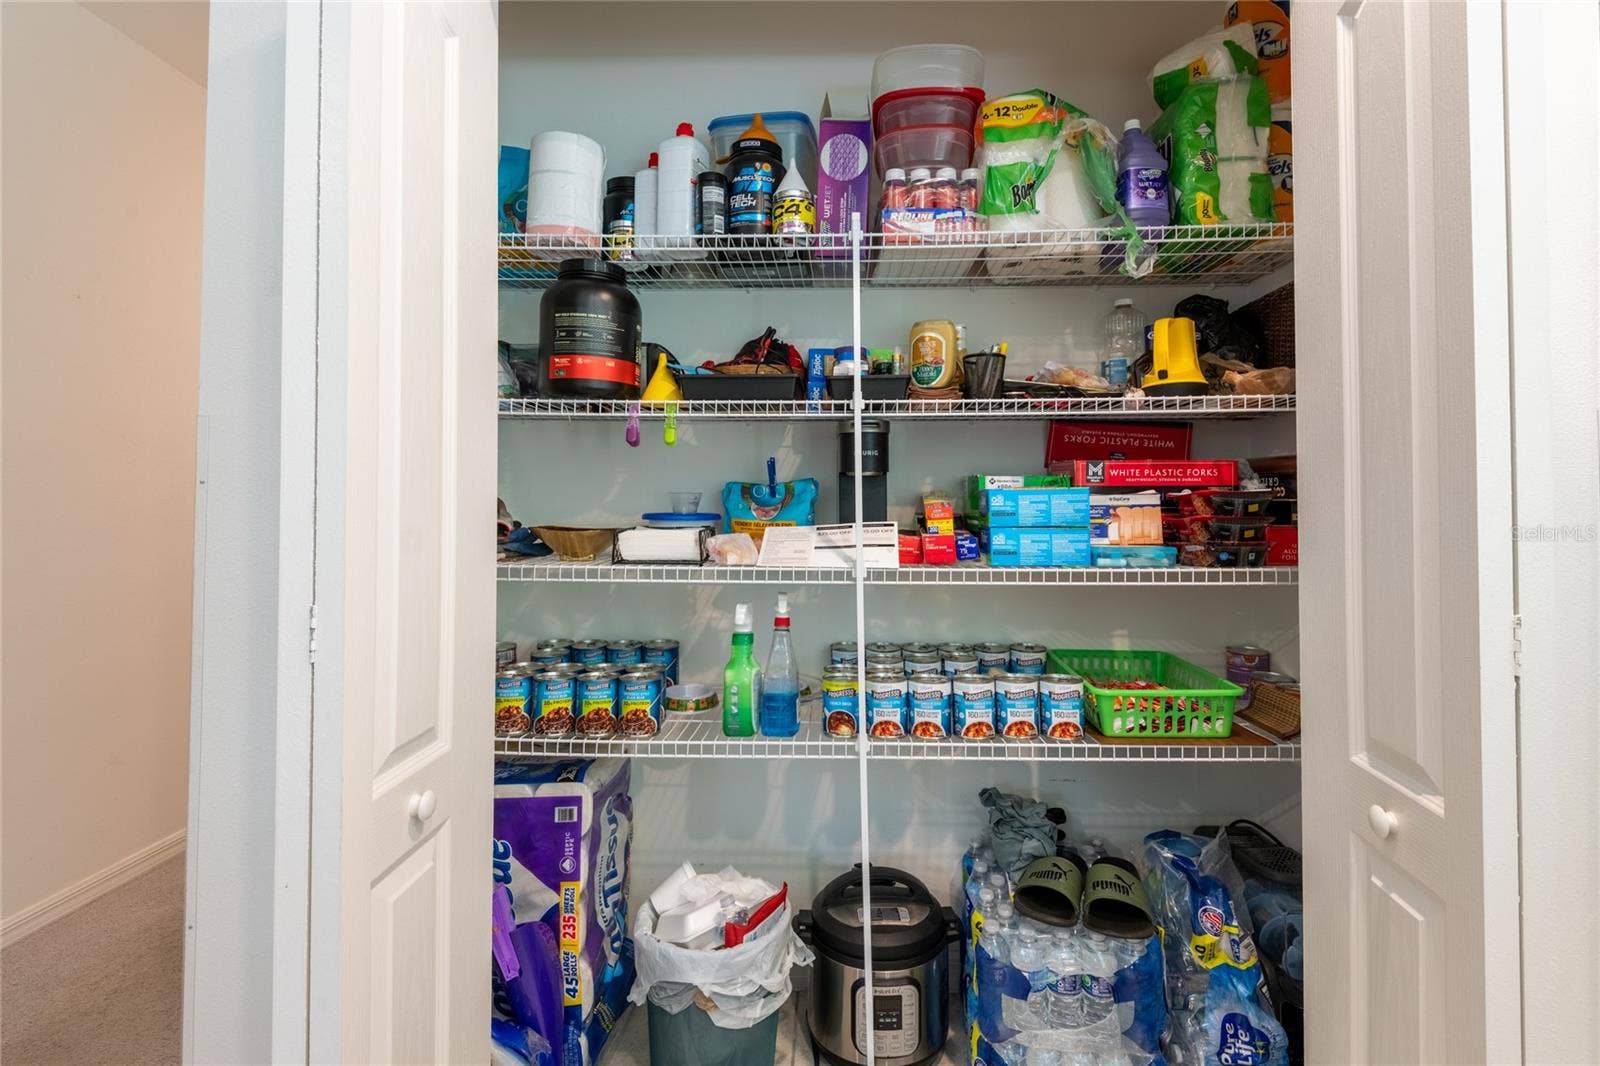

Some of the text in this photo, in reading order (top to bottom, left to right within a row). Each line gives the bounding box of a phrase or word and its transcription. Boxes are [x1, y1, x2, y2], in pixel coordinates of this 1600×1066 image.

[731, 194, 754, 202] CELL
[813, 354, 823, 376] Ziploc
[1064, 434, 1175, 448] WHITE PLASTIC FORKS
[1110, 468, 1219, 476] WHITE PLASTIC FORKS
[1029, 870, 1063, 880] PUMA
[1092, 880, 1130, 896] PUMA
[562, 915, 577, 939] 235
[563, 951, 571, 977] LARGE
[565, 977, 578, 999] 45
[1221, 1022, 1235, 1066] Pure
[1235, 1030, 1256, 1066] Life
